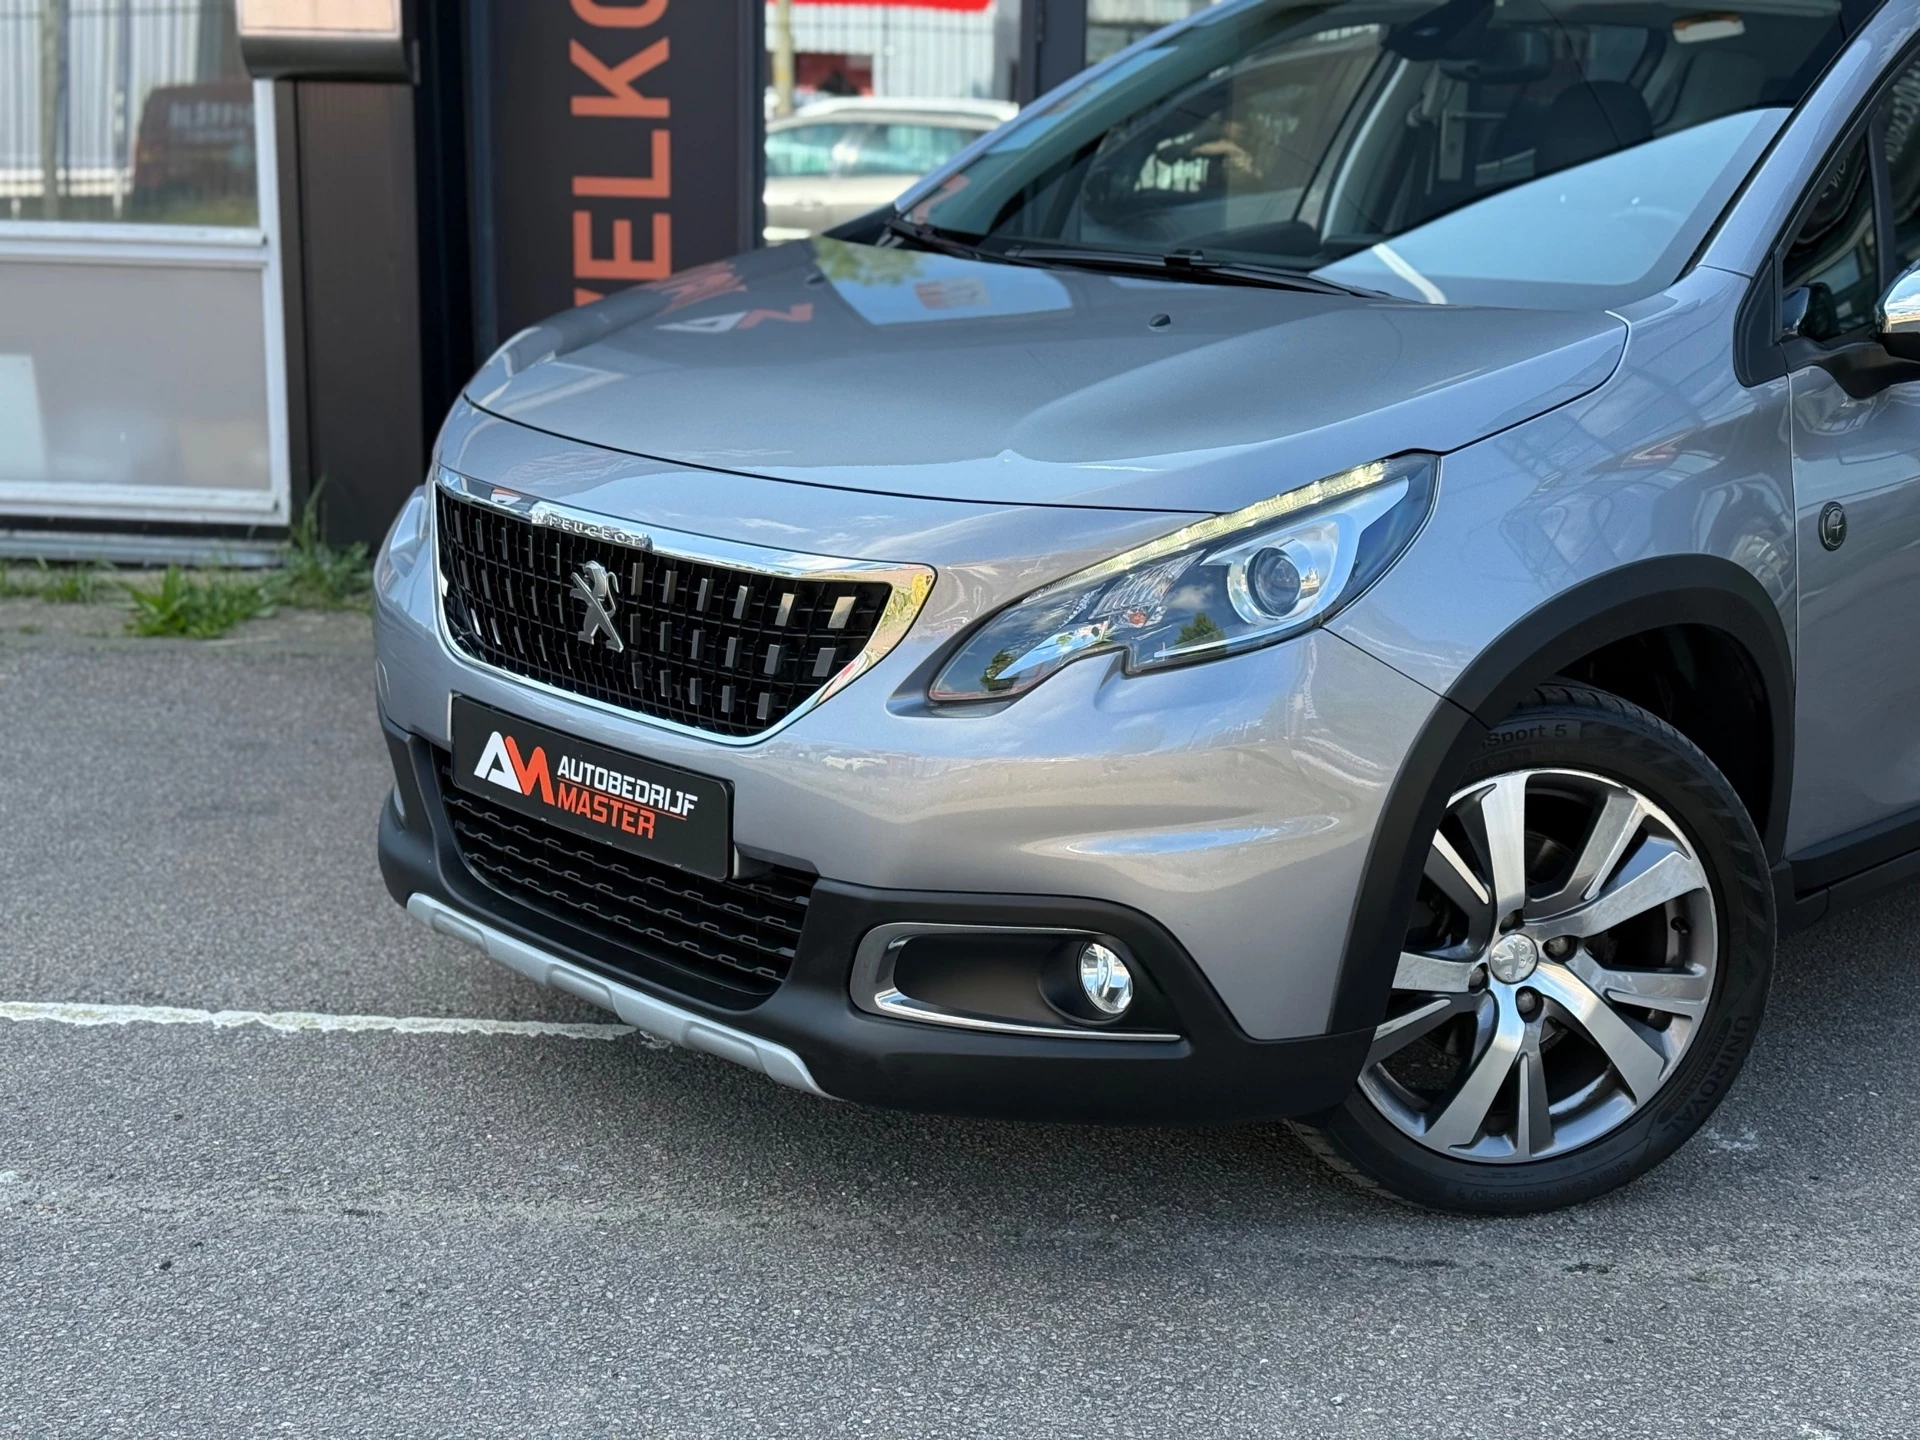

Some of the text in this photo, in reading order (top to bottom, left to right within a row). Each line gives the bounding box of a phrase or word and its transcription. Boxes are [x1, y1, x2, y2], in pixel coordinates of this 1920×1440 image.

[569, 0, 672, 307] ELK
[548, 515, 641, 547] PEUGEOT
[1555, 724, 1568, 738] 5
[557, 755, 698, 817] AUTOBEDRIJF
[557, 782, 656, 840] MASTER
[1663, 1016, 1751, 1132] UNIROYAL
